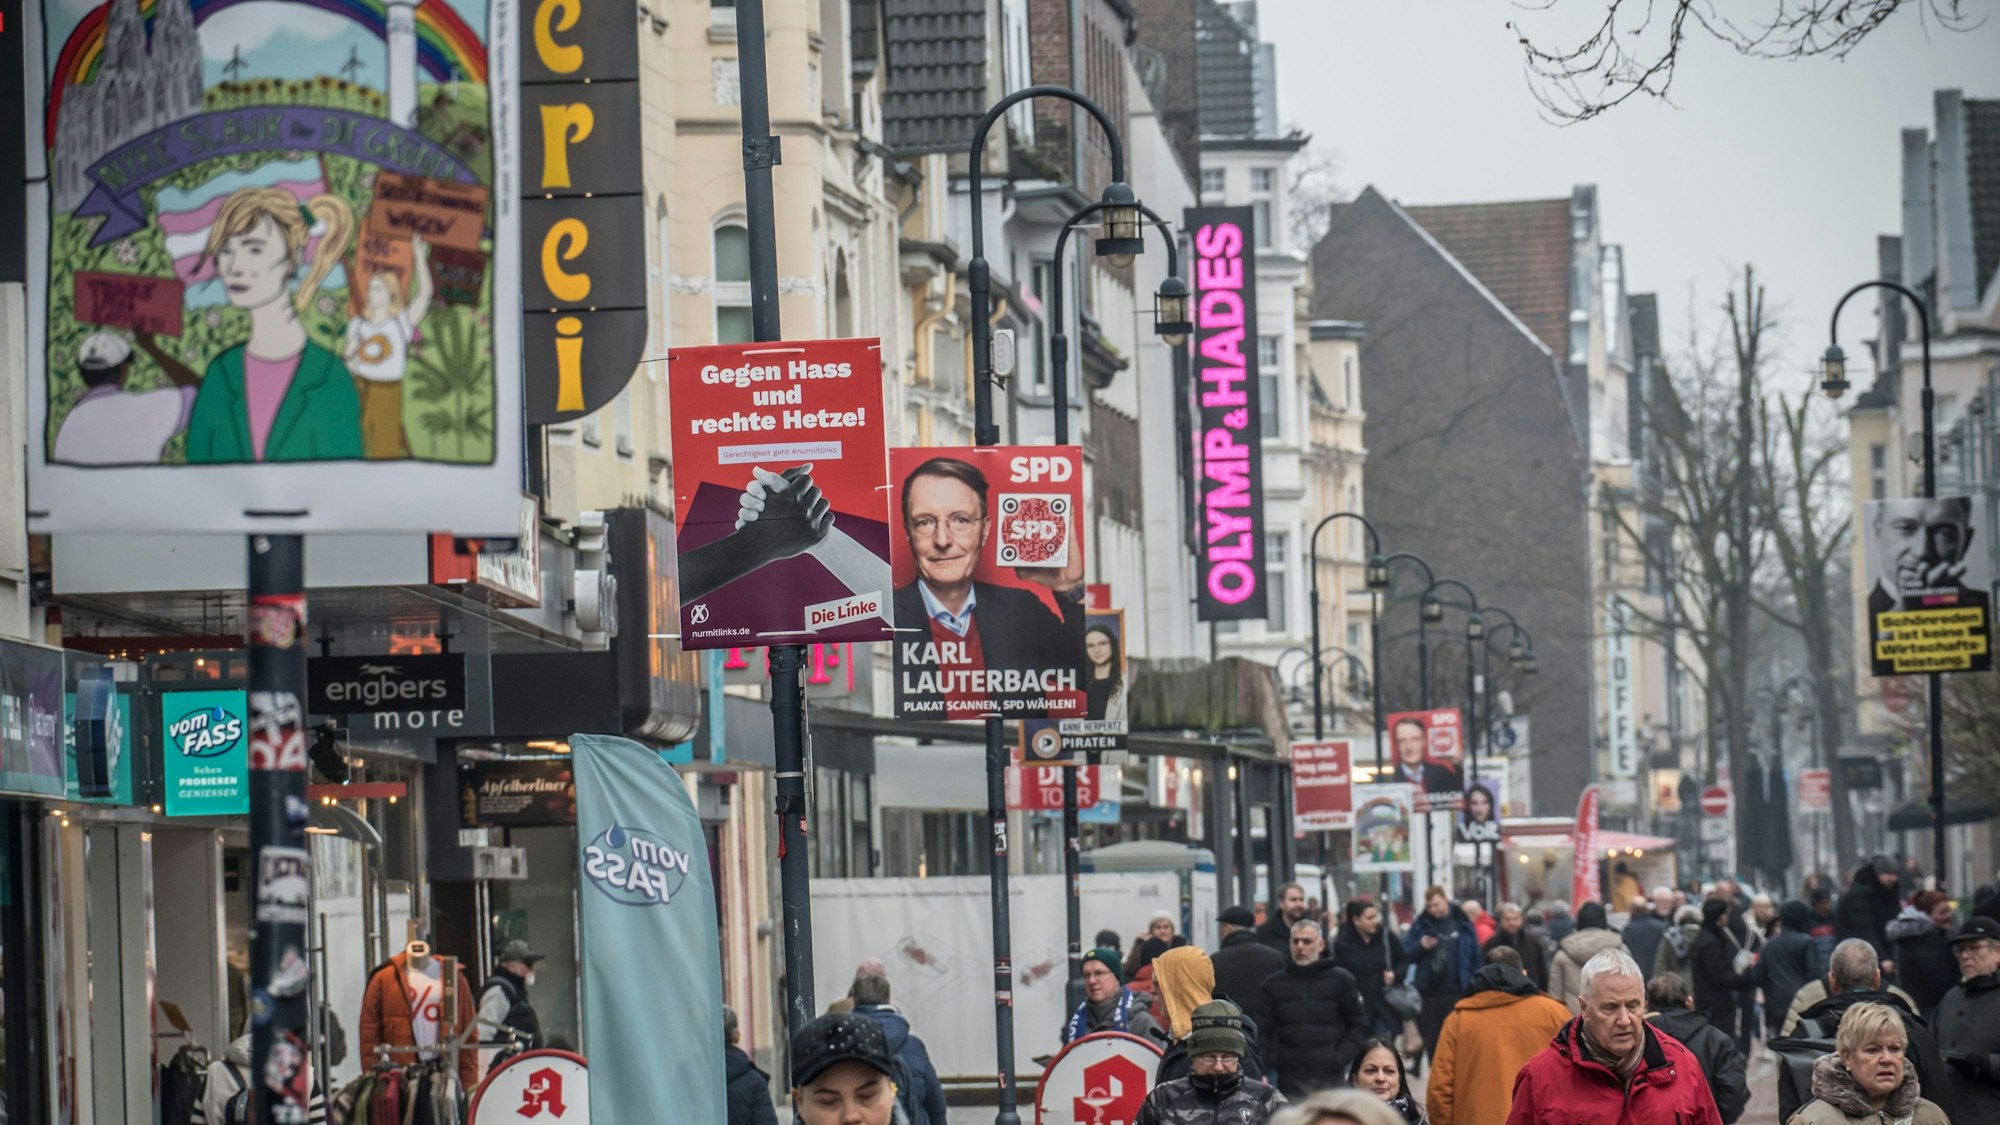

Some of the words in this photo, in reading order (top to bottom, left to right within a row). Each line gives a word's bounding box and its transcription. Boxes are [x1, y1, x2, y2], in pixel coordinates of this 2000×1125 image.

[700, 363, 782, 388] Gegen
[788, 360, 852, 380] Hass
[752, 384, 802, 407] und
[691, 412, 776, 435] rechte
[783, 407, 866, 430] Hetze!
[722, 450, 771, 459] Gerechtigkeit
[773, 448, 790, 458] geht
[792, 446, 838, 456] #nurmitlinks
[1010, 456, 1073, 483] SPD
[1010, 519, 1058, 541] SPD
[811, 608, 836, 625] Die
[837, 600, 878, 620] Linke
[691, 626, 751, 639] nurmitlinks.de
[902, 641, 972, 666] KARL
[325, 674, 447, 706] engbers
[902, 669, 1077, 695] LAUTERBACH
[903, 700, 945, 712] PLAKAT
[946, 699, 1002, 712] SCANNEN,
[1003, 699, 1026, 710] SPD
[1026, 697, 1077, 710] WÄHLEN!
[169, 713, 208, 738] vom
[374, 708, 464, 730] more
[1062, 721, 1083, 732] ANNE
[1084, 720, 1122, 732] HERPERTZ
[183, 718, 242, 756] FASS
[1062, 736, 1117, 749] PIRATEN
[178, 776, 239, 788] PROBIEREN
[178, 787, 240, 799] GENIESSEN
[480, 778, 567, 797] Apfelberliner
[1037, 786, 1092, 807] TOR
